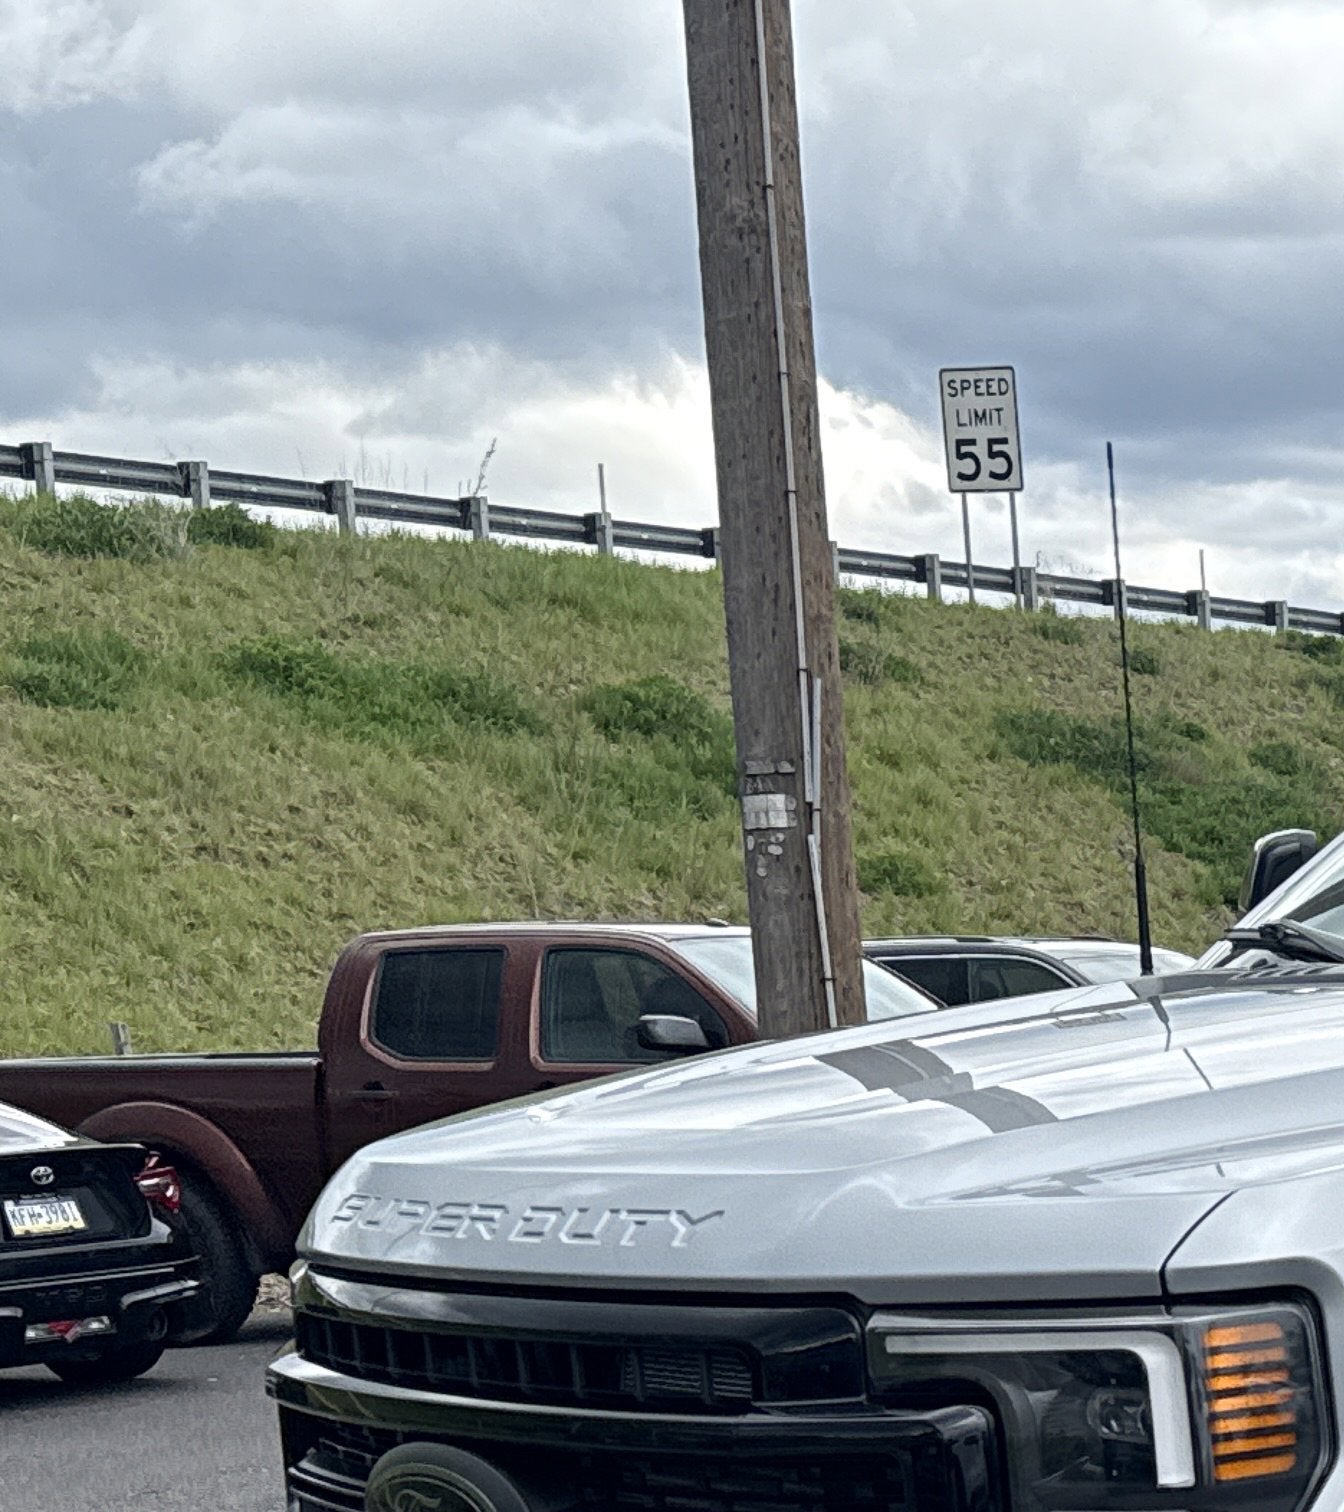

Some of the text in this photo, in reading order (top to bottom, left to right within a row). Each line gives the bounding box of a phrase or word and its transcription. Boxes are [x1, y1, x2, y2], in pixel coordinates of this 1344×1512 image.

[947, 377, 1009, 398] SPEED
[955, 408, 1004, 427] LIMIT
[955, 437, 1013, 481] 55
[330, 1193, 725, 1249] SUPER DUTY
